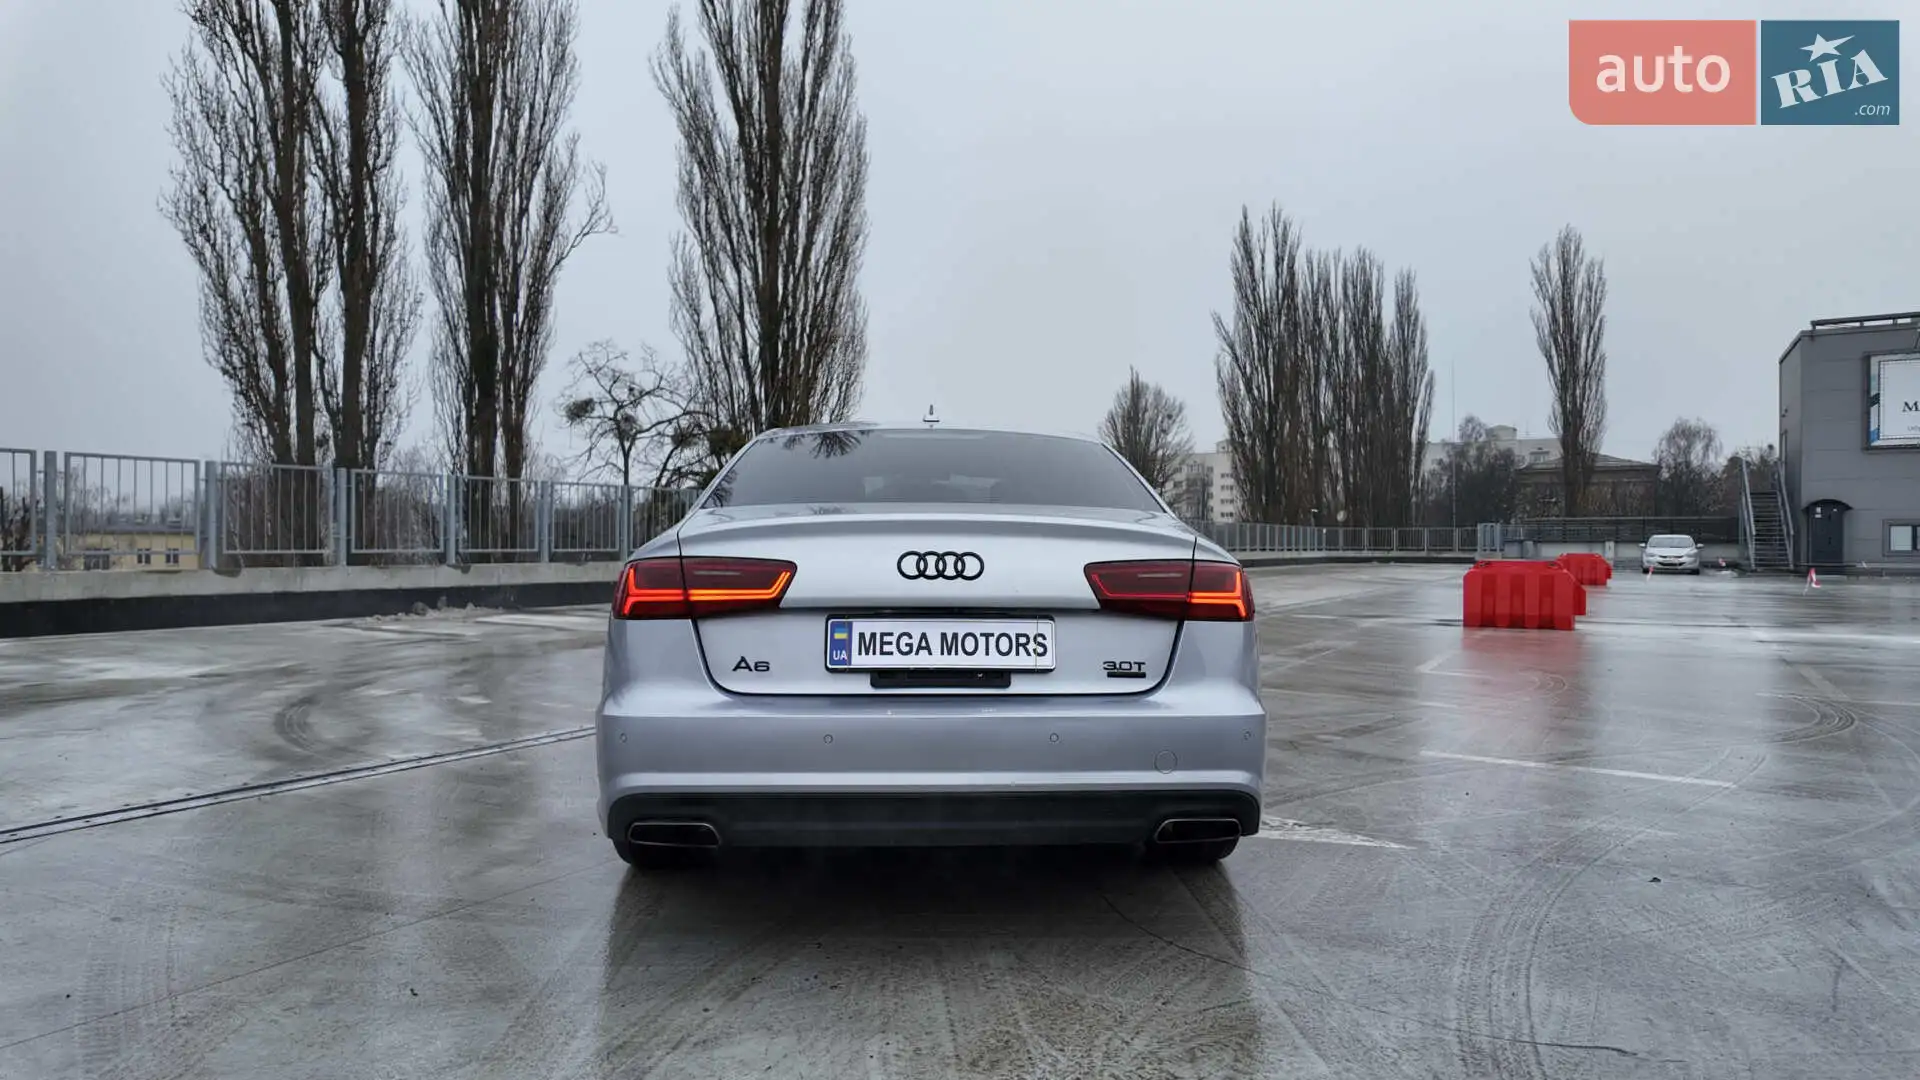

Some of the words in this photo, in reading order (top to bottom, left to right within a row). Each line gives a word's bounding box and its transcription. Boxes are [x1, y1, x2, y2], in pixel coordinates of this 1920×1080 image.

[857, 631, 933, 656] MEGA
[940, 632, 1048, 657] MOTORS
[732, 655, 770, 672] A6
[833, 649, 848, 661] UA
